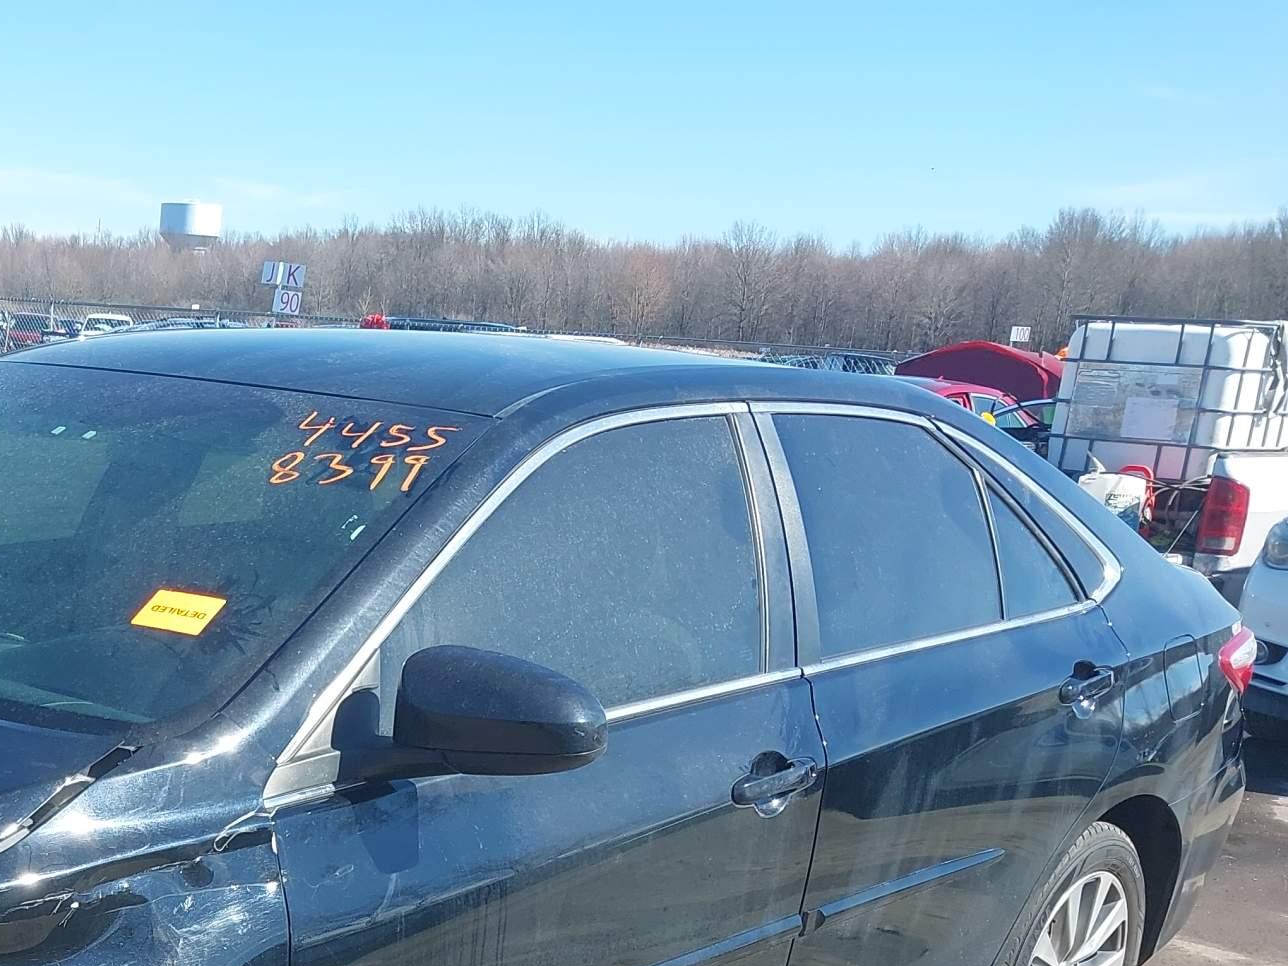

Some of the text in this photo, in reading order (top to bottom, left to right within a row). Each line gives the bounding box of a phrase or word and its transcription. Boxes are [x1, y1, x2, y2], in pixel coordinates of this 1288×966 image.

[266, 262, 301, 286] J K
[279, 291, 300, 313] 90
[1015, 327, 1030, 341] 100
[299, 411, 462, 451] 4455
[269, 451, 431, 491] 8399
[151, 604, 208, 620] DETAILED
